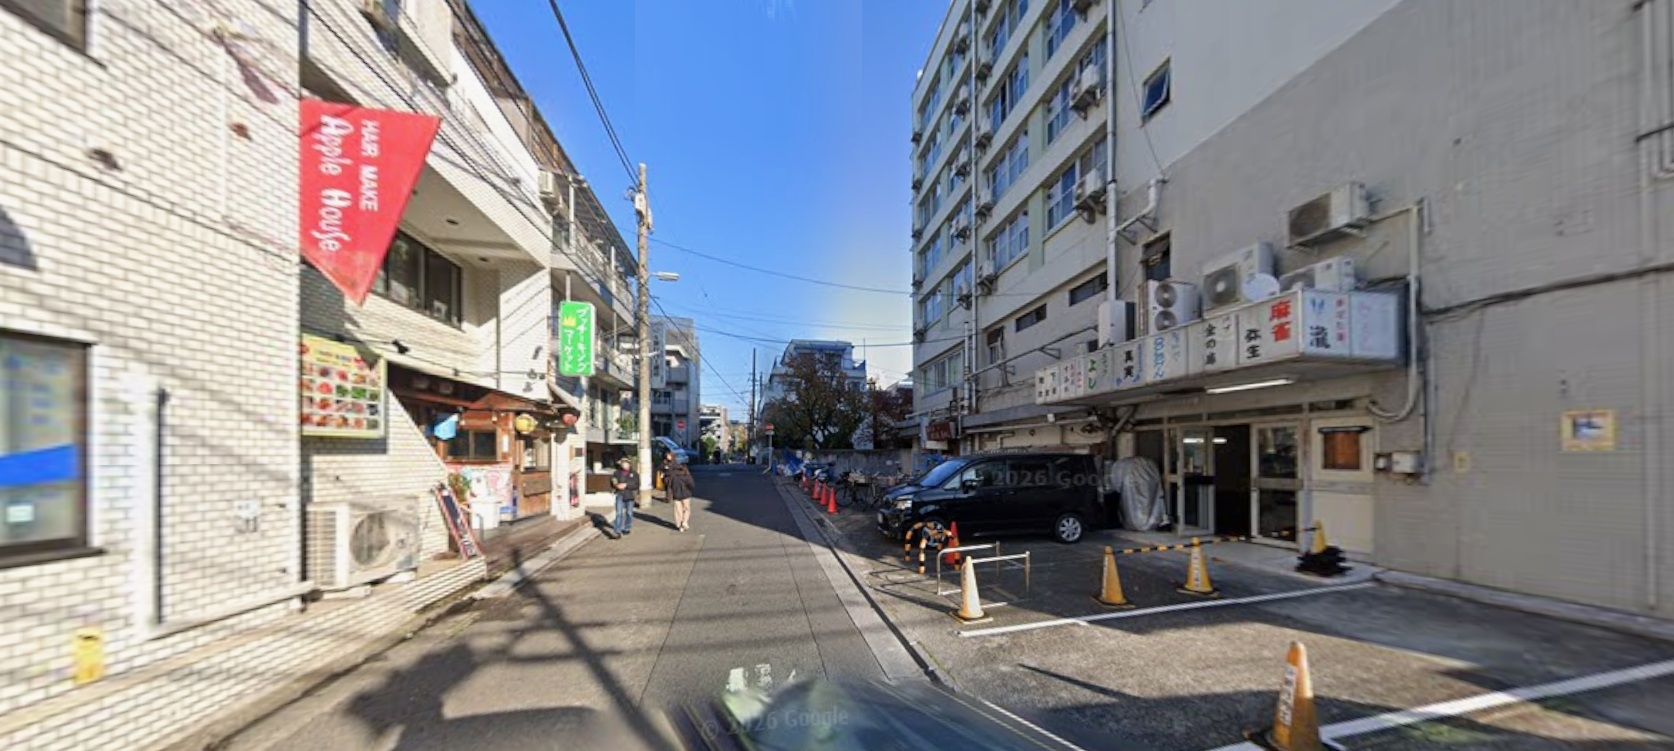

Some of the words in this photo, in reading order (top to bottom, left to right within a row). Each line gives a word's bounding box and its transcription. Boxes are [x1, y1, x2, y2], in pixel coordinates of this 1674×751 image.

[311, 115, 354, 175] Apple
[361, 119, 380, 158] HAIR
[358, 165, 379, 212] MAKE
[310, 188, 352, 253] House
